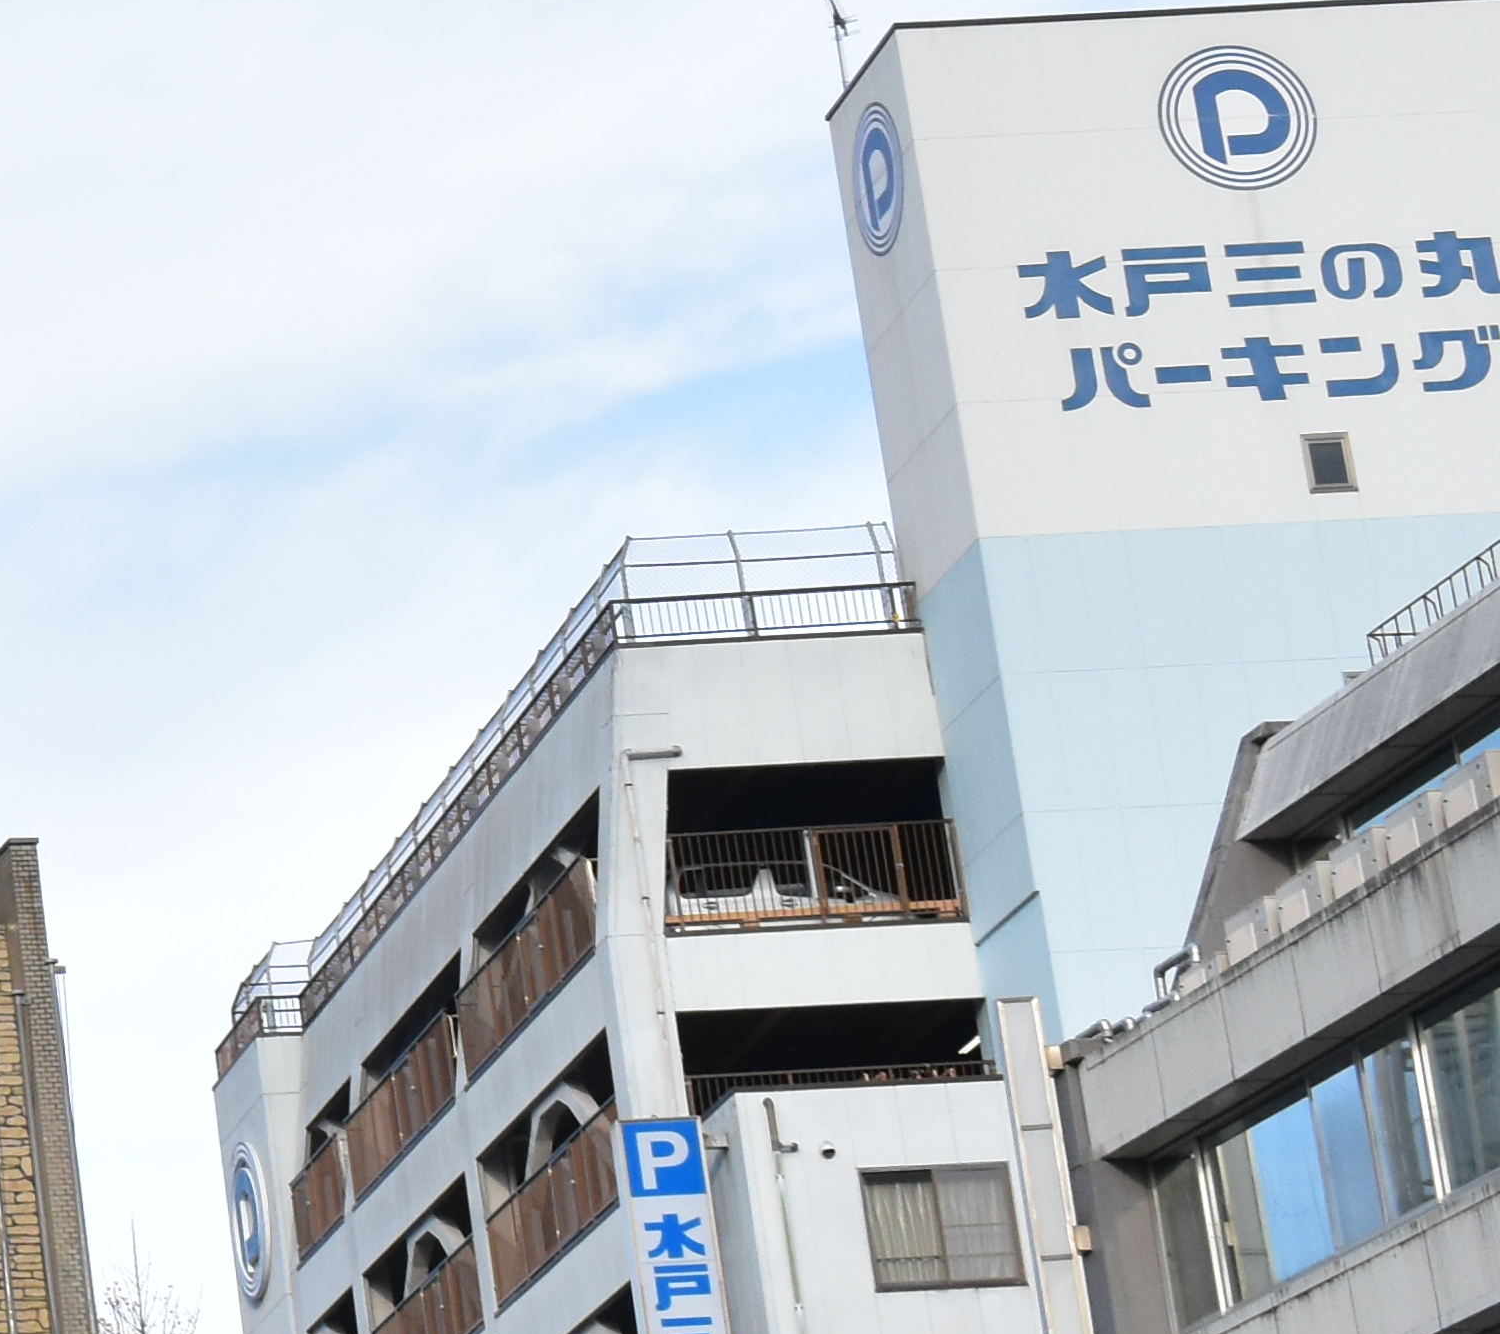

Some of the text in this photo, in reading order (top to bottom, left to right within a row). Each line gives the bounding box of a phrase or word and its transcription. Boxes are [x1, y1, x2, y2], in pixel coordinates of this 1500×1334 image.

[1017, 230, 1500, 319] 水戸三の丸
[1061, 324, 1500, 412] パーキング
[636, 1130, 690, 1190] P
